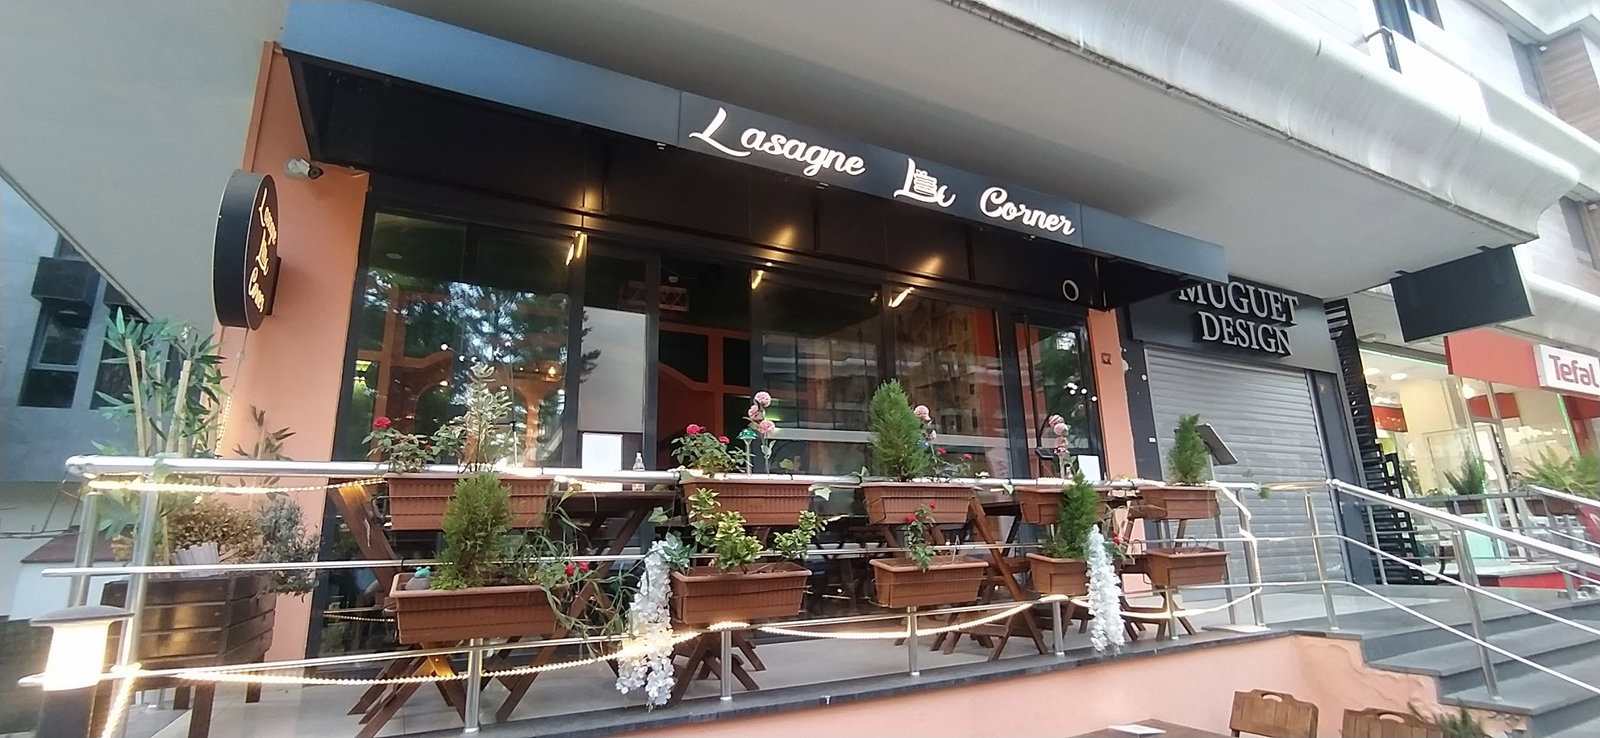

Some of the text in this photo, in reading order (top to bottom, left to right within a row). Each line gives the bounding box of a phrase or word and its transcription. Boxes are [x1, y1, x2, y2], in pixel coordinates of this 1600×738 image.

[689, 107, 865, 176] Lasagne
[979, 187, 1074, 235] Corner
[1198, 311, 1293, 355] DESIGN
[1549, 354, 1599, 388] Tefal
